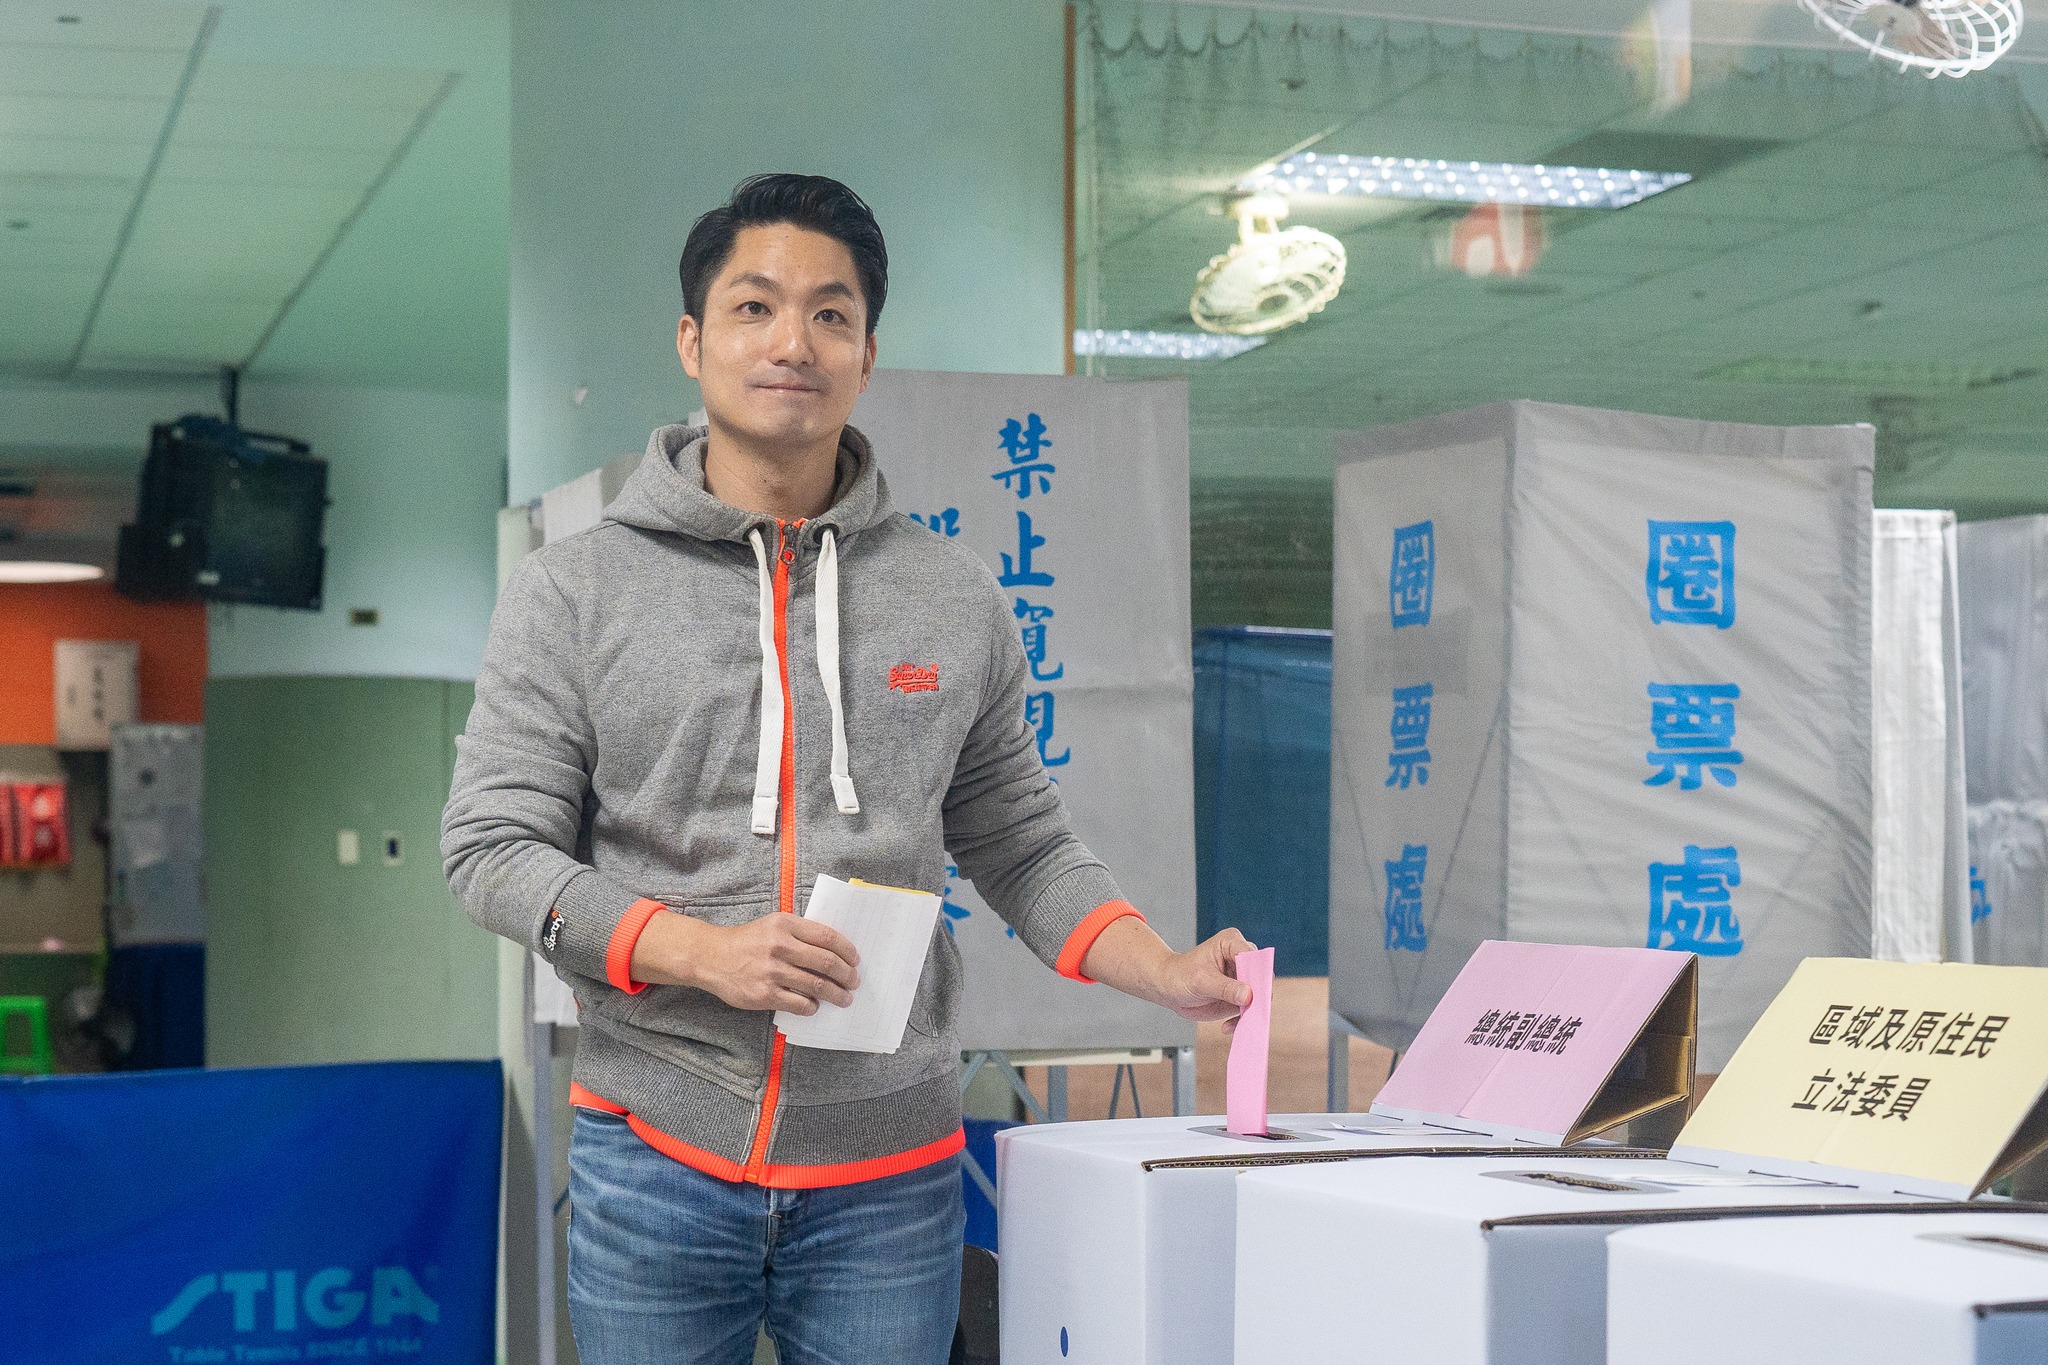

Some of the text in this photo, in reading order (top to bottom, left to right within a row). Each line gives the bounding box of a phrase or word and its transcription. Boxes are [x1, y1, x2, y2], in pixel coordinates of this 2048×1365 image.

[1384, 520, 1435, 953] 圈票處
[1643, 519, 1745, 957] 圈票處
[1464, 1008, 1583, 1056] 總統副總統
[1808, 1003, 2011, 1059] 區域及原住民
[1791, 1067, 1931, 1122] 立法委員
[151, 1266, 440, 1336] STIGA
